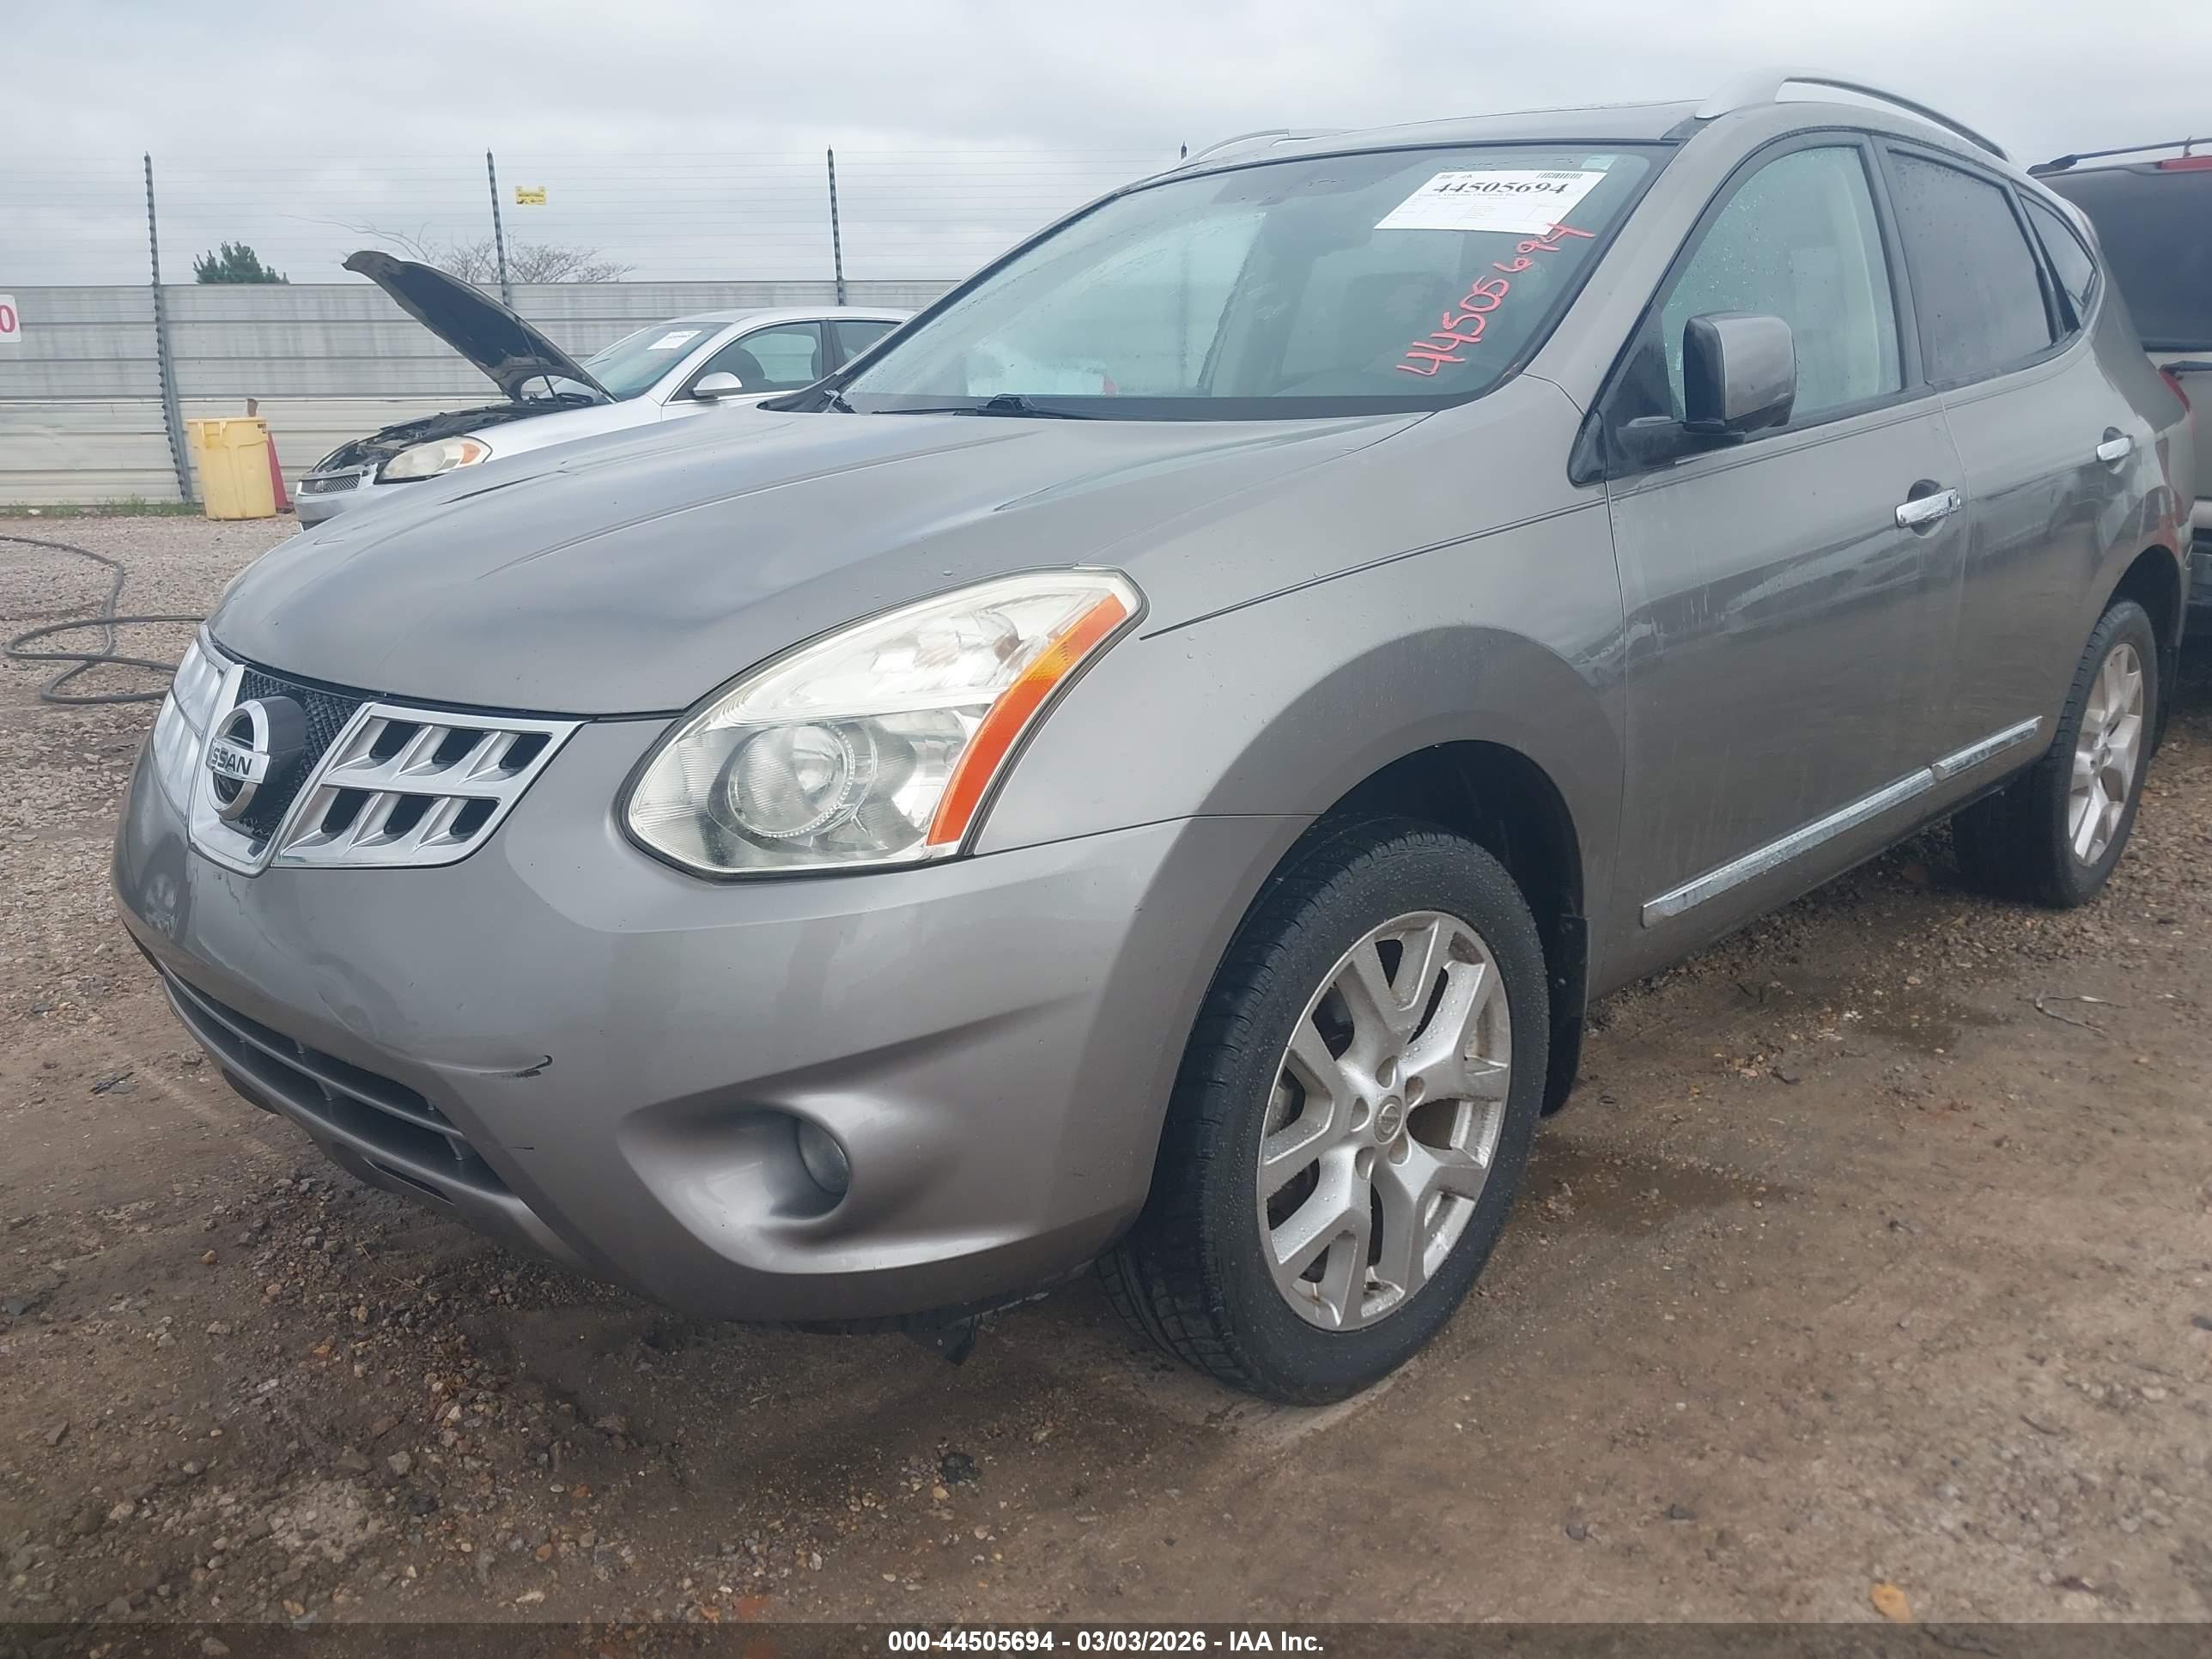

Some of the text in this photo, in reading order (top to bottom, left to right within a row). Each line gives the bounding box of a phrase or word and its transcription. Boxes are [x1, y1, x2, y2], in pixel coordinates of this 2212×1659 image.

[1432, 182, 1570, 194] 44505694
[1396, 222, 1595, 376] 44505694
[210, 747, 252, 775] SSAN
